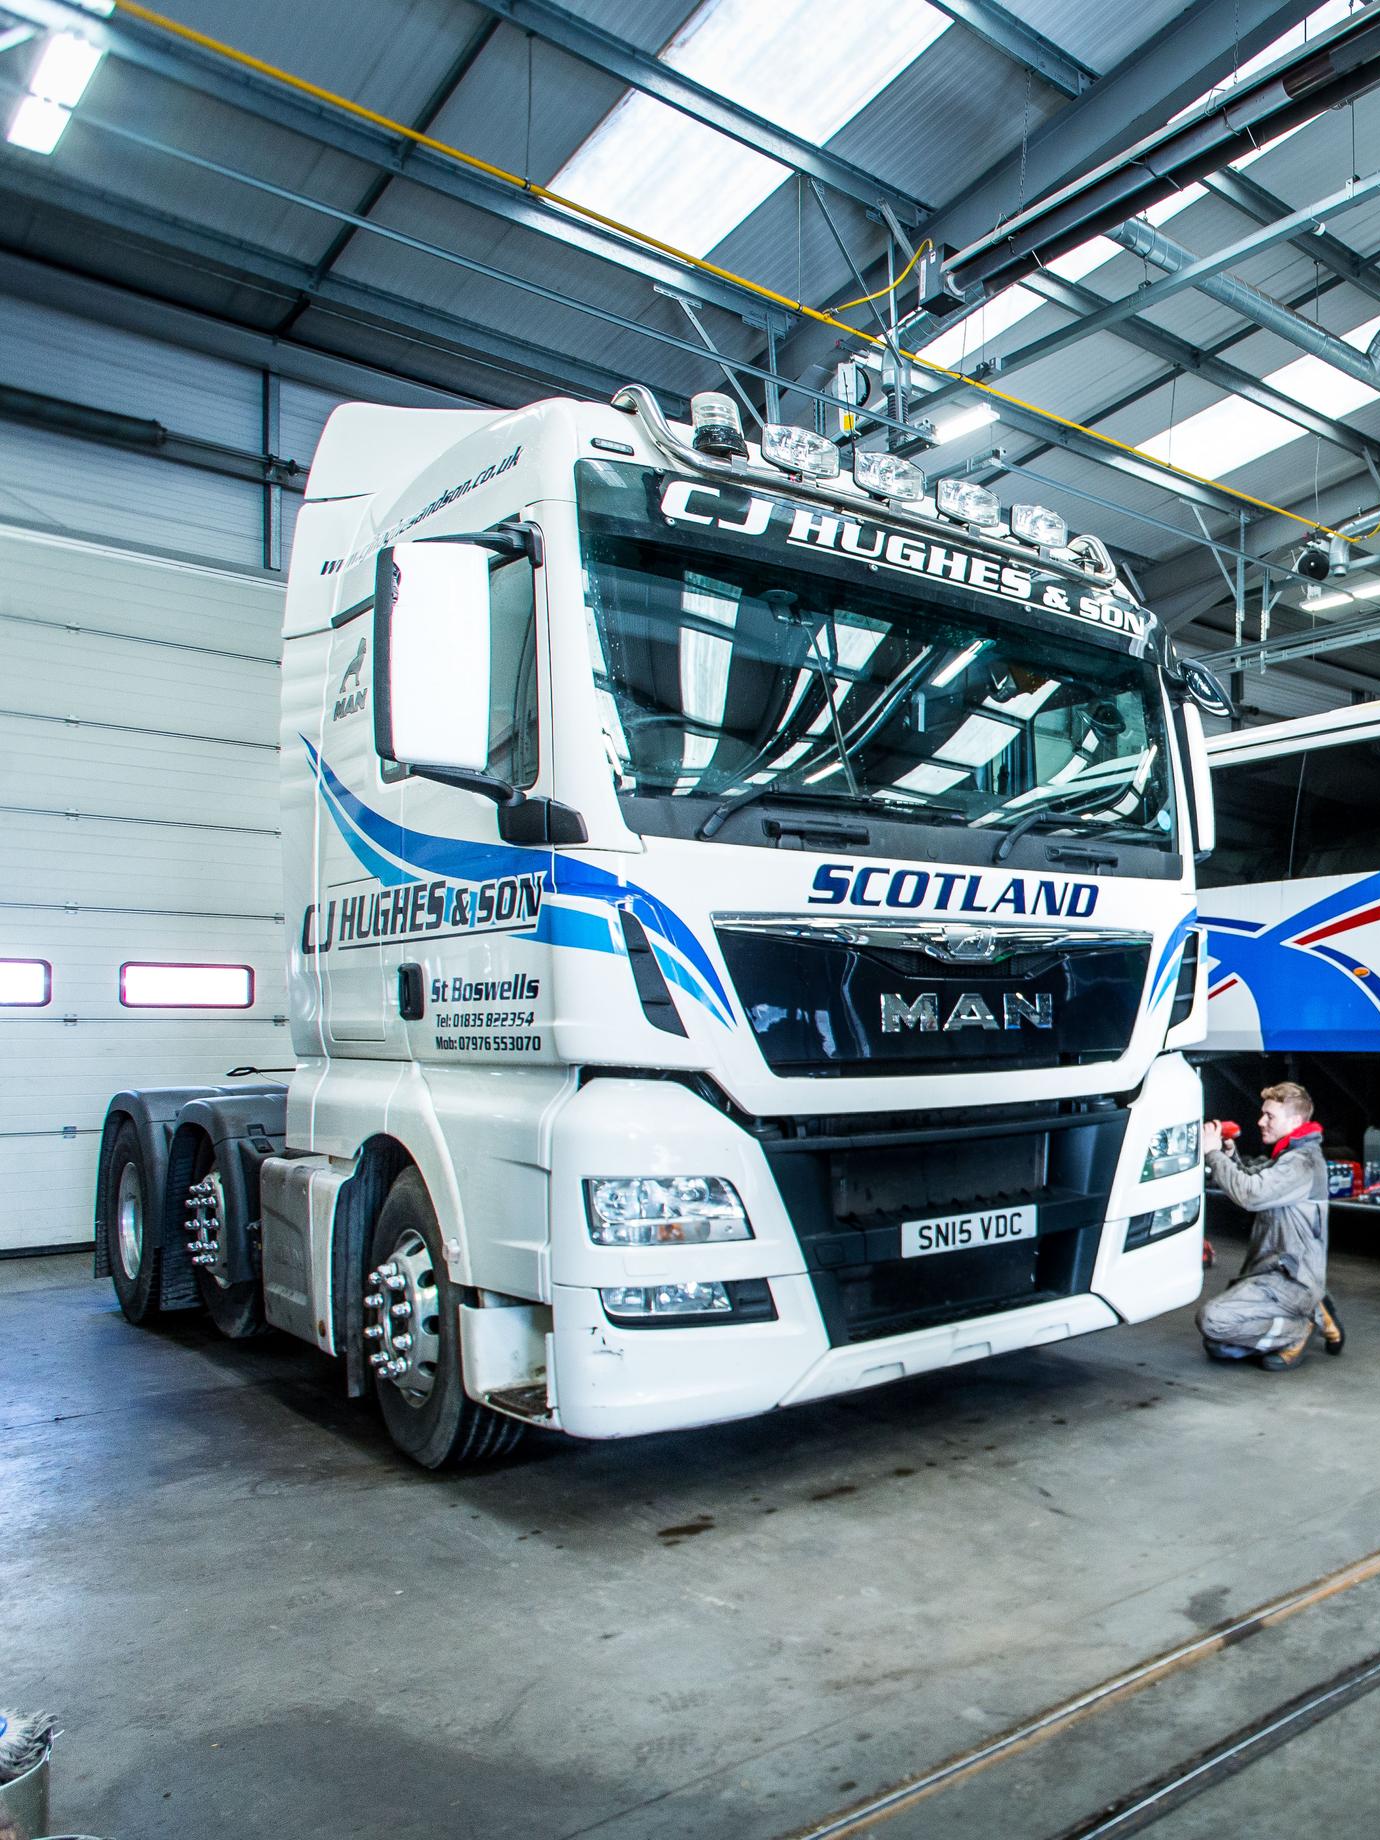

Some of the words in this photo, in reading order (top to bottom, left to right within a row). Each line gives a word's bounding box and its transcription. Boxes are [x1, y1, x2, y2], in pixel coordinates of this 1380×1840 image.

[660, 480, 777, 537] CJ
[787, 508, 1032, 600] HUGHES
[1043, 585, 1072, 611] &
[1080, 596, 1146, 637] SON
[333, 688, 368, 721] MAN
[807, 864, 1100, 918] SCOTLAND
[302, 900, 336, 955] CJ
[339, 880, 447, 942] HUGHES
[451, 887, 470, 927] &
[477, 875, 543, 924] SON
[431, 978, 448, 1003] St
[451, 973, 539, 1002] Boswells
[436, 1013, 451, 1028] Tel:
[453, 1012, 484, 1028] 01835
[486, 1011, 535, 1028] 822354
[880, 992, 1054, 1034] MAN
[435, 1036, 457, 1050] Mob:
[458, 1036, 491, 1051] 07976
[493, 1036, 541, 1052] 553070
[918, 1220, 972, 1251] SN15
[980, 1212, 1023, 1241] VDC
